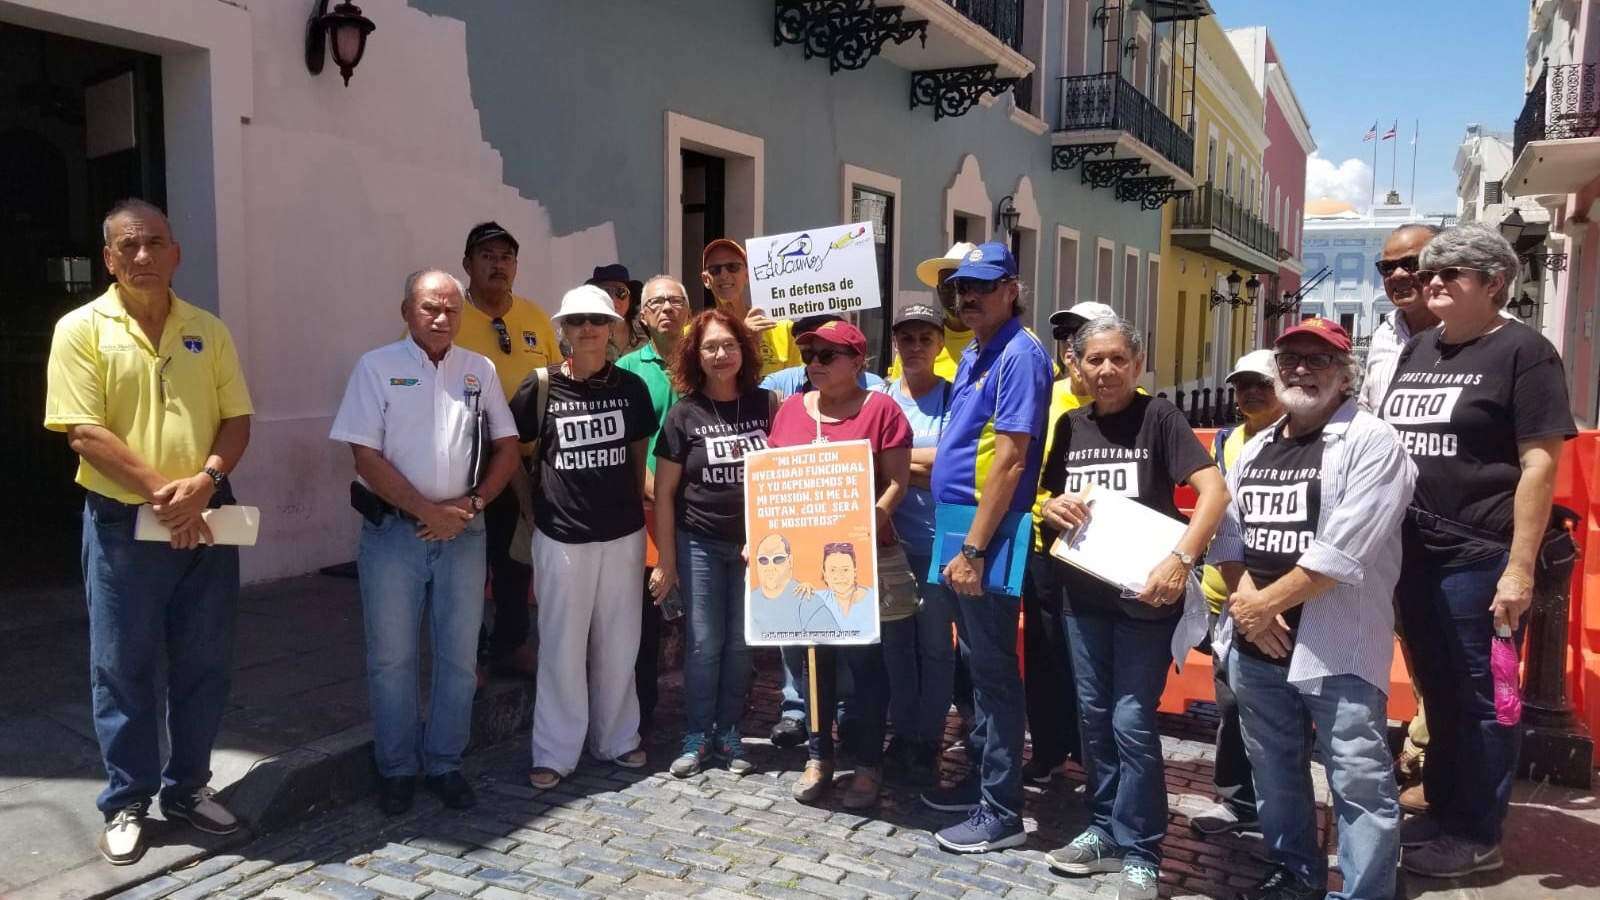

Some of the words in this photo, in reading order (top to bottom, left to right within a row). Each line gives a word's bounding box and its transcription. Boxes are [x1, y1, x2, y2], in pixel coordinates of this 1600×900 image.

[771, 287, 786, 299] En
[789, 281, 836, 297] defensa
[839, 278, 854, 290] de
[771, 306, 786, 317] un
[789, 300, 825, 315] Retiro
[828, 296, 862, 311] Digno
[1389, 393, 1447, 417] OTRO
[563, 416, 617, 442] OTRO
[555, 446, 626, 470] ACUERDO
[819, 451, 839, 463] CON
[805, 462, 865, 477] FUNCIONAL
[757, 482, 764, 493] Y
[767, 480, 781, 491] YO
[782, 477, 844, 490] DEPENDEMOS
[846, 475, 858, 486] DE
[1069, 468, 1127, 493] OTRO
[757, 495, 768, 506] MI
[815, 490, 824, 501] SI
[827, 489, 840, 500] ME
[843, 487, 859, 499] LA
[1242, 490, 1298, 515] OTRO
